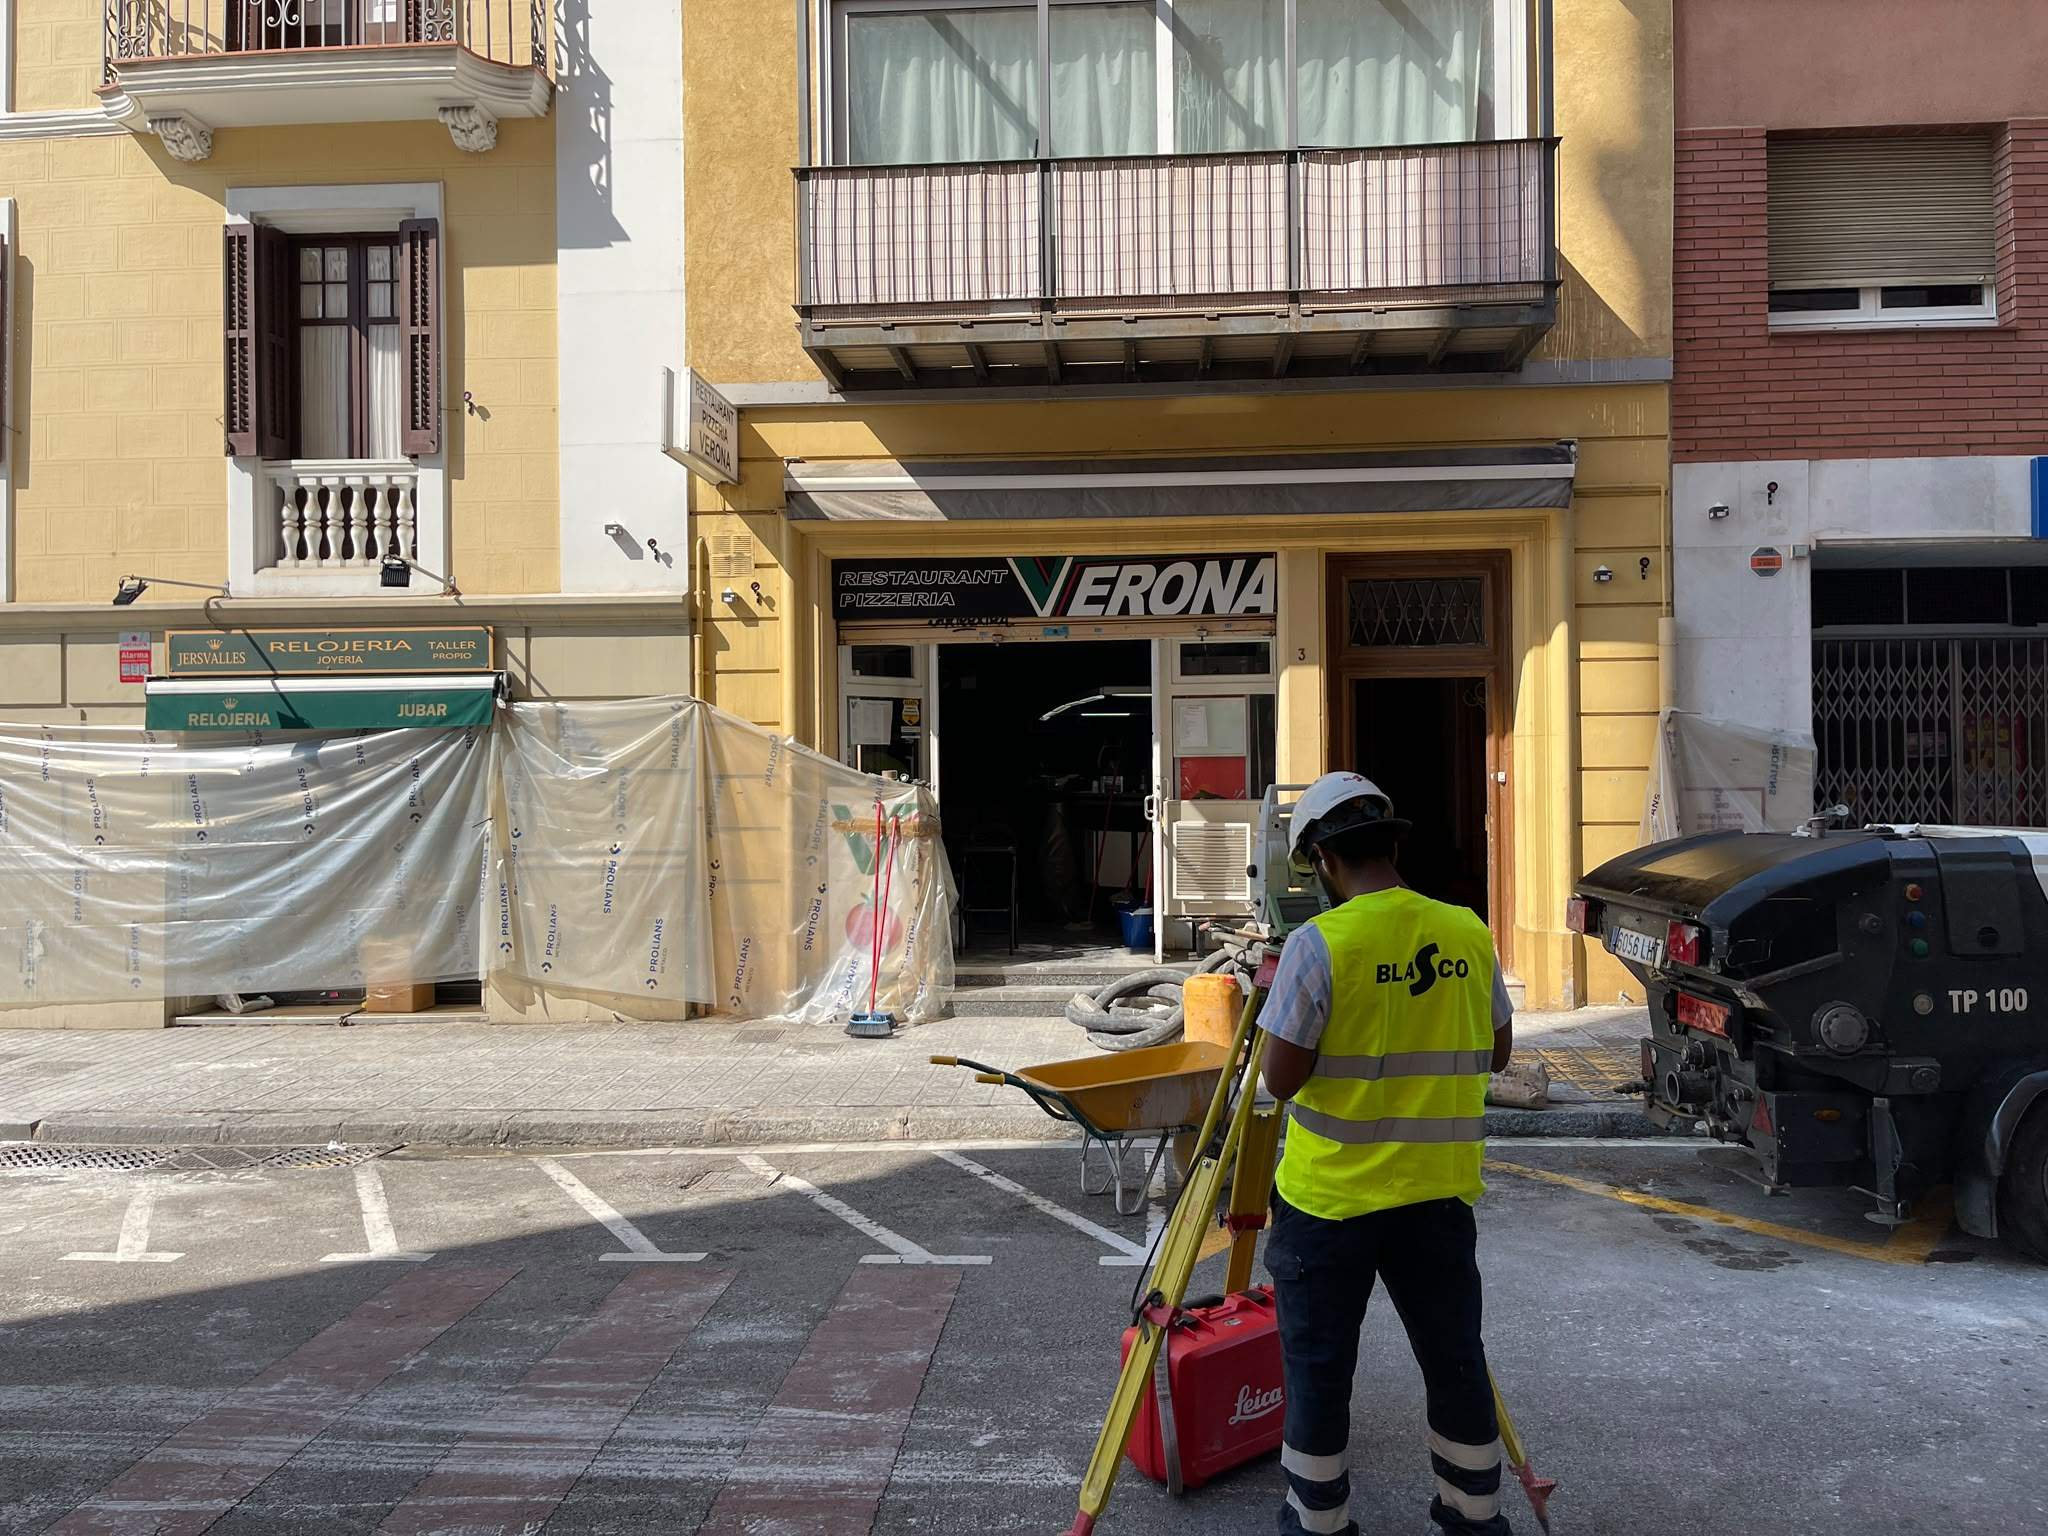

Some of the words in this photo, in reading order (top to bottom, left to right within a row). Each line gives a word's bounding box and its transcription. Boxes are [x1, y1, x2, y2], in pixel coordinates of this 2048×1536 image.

[695, 380, 734, 425] RESTAURANT
[702, 409, 729, 444] PIZZERIA
[699, 430, 732, 472] VERONA
[839, 569, 1009, 586] RESTAURANT
[1006, 555, 1276, 617] VERONA
[839, 592, 956, 608] PIZZERIA
[121, 651, 149, 659] Alarma
[177, 651, 246, 667] JERSVALLES
[269, 639, 413, 653] RELOJERIA
[316, 655, 364, 665] JOYERIA
[428, 640, 477, 650] TALLER
[432, 652, 472, 660] PROPIO
[1297, 647, 1306, 661] 3
[188, 712, 271, 727] RELOJERIA
[397, 703, 447, 717] JUBAR
[41, 734, 53, 782] POLIANS
[86, 779, 101, 830] PROLIANS
[189, 774, 204, 825] PROLIANS
[298, 768, 313, 818] PROLIANS
[604, 860, 617, 914] PROLIANS
[500, 882, 509, 936] PROLIANS
[804, 898, 822, 951] PROLIANS
[545, 904, 558, 956] PROLIANS
[649, 918, 664, 973] PROLIANS
[1615, 931, 1640, 956] 6056
[734, 937, 751, 990] PROLIANS
[1376, 943, 1469, 997] BLASCO
[1948, 990, 1978, 1014] TP
[1985, 988, 2028, 1012] 100
[1228, 1385, 1284, 1425] Leica
